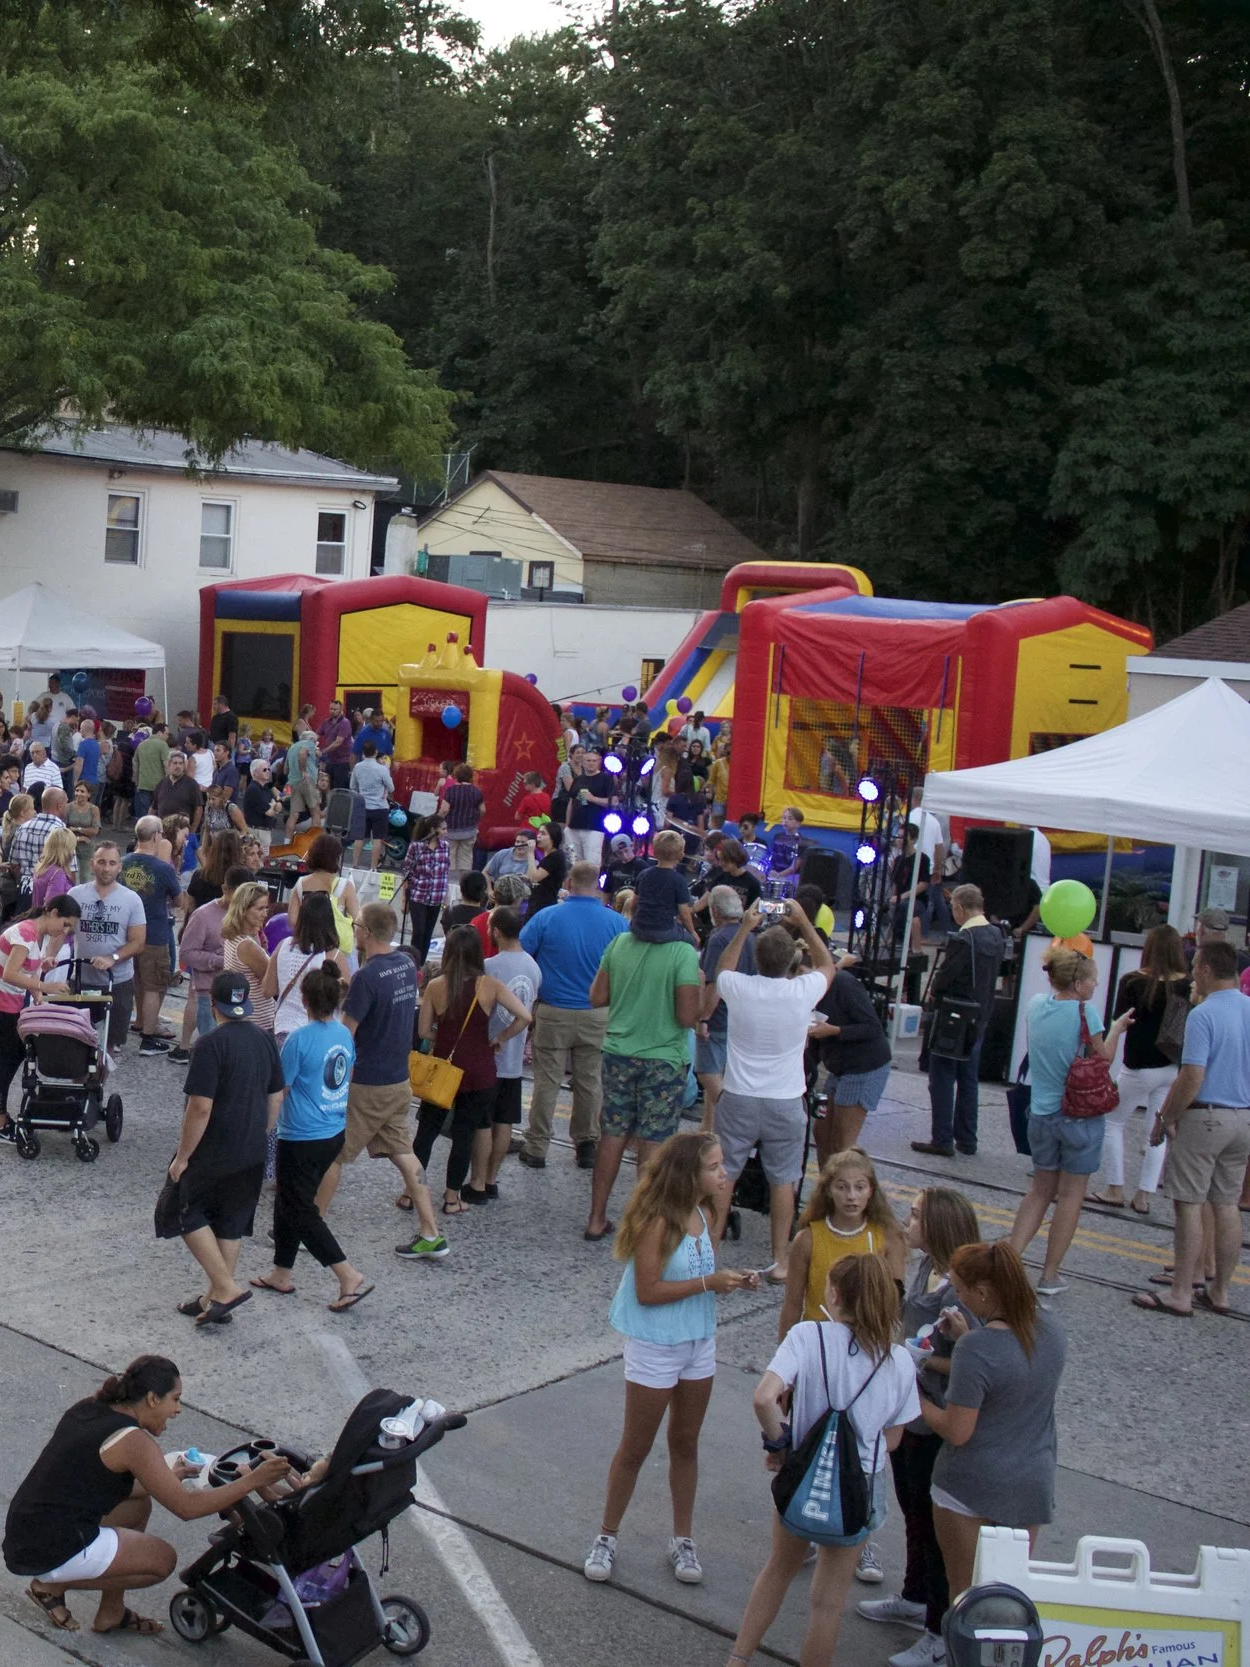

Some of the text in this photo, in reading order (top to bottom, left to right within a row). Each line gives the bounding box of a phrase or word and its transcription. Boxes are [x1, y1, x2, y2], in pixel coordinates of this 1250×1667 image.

[81, 902, 98, 912] THIS
[106, 922, 119, 934] DAY
[85, 933, 108, 943] SHIRT
[379, 969, 393, 978] BMW
[396, 972, 406, 980] CAR
[1042, 1631, 1149, 1667] Ralph's
[1152, 1640, 1196, 1655] Famous
